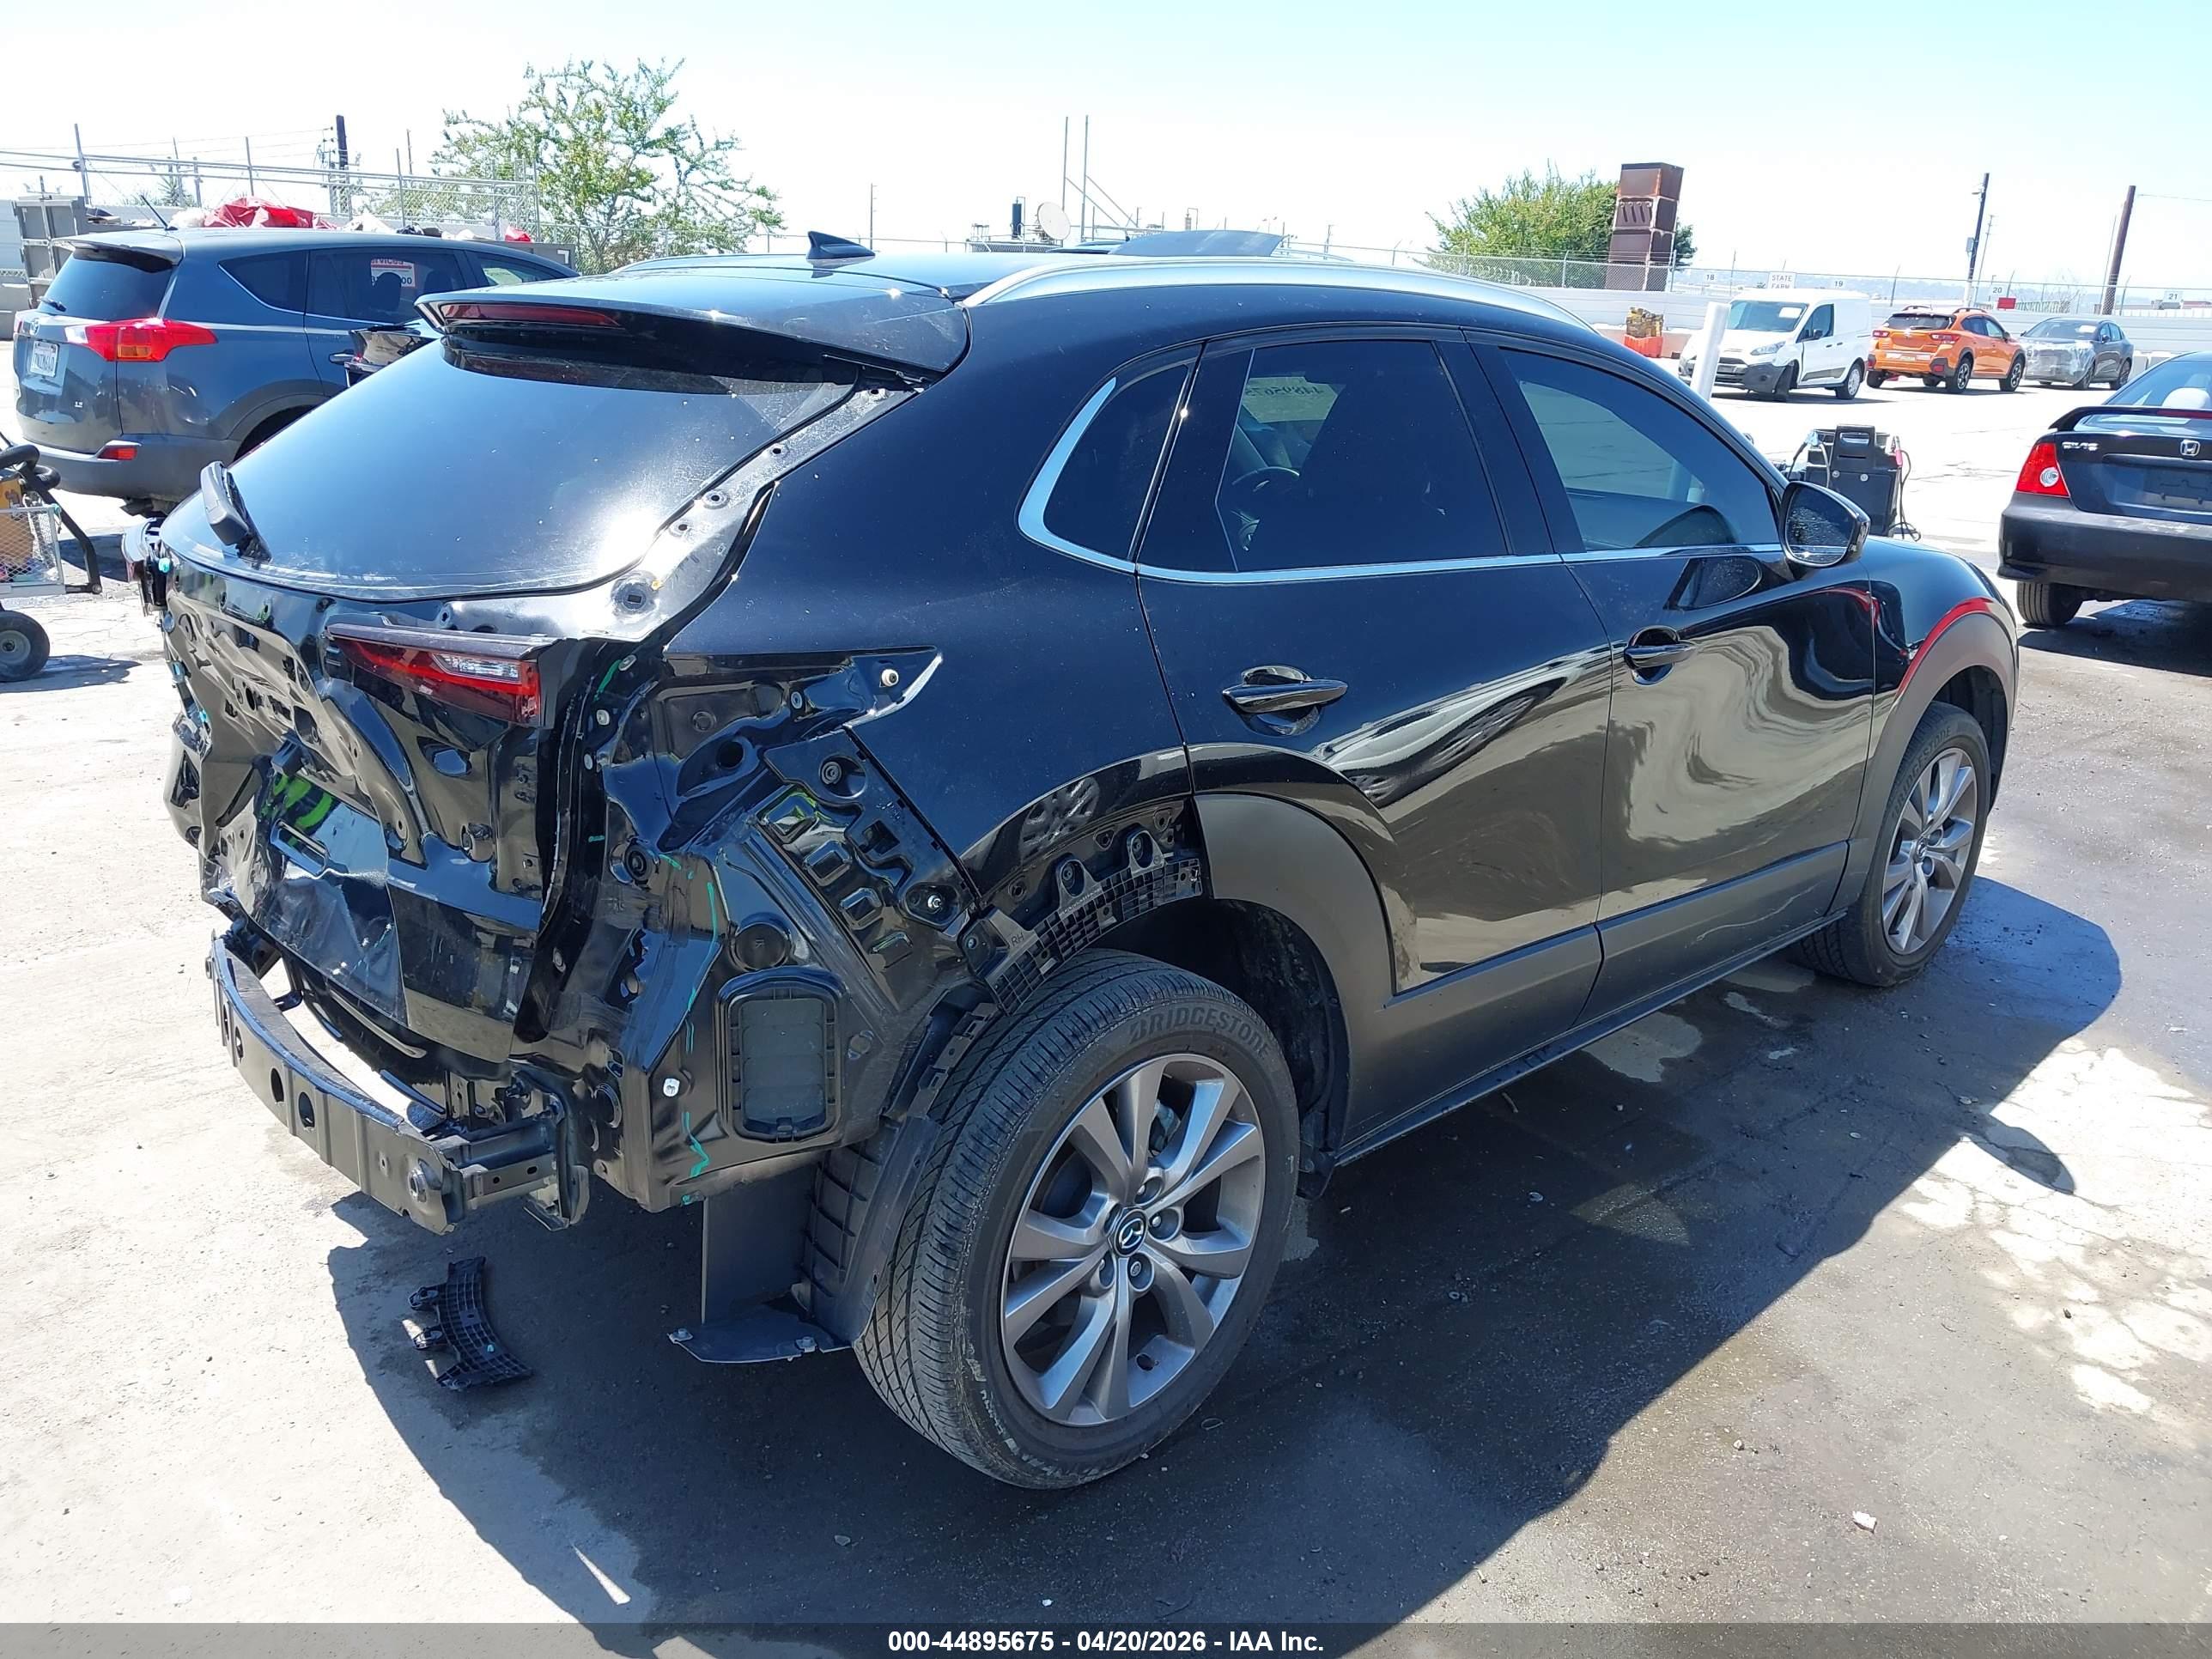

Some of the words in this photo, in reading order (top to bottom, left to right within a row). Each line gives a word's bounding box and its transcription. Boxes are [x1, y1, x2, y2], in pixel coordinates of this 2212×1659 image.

[1771, 274, 1793, 283] STATE
[2168, 292, 2179, 301] 21
[1011, 932, 1024, 946] RH
[1128, 1006, 1273, 1060] BRIDGESTONE
